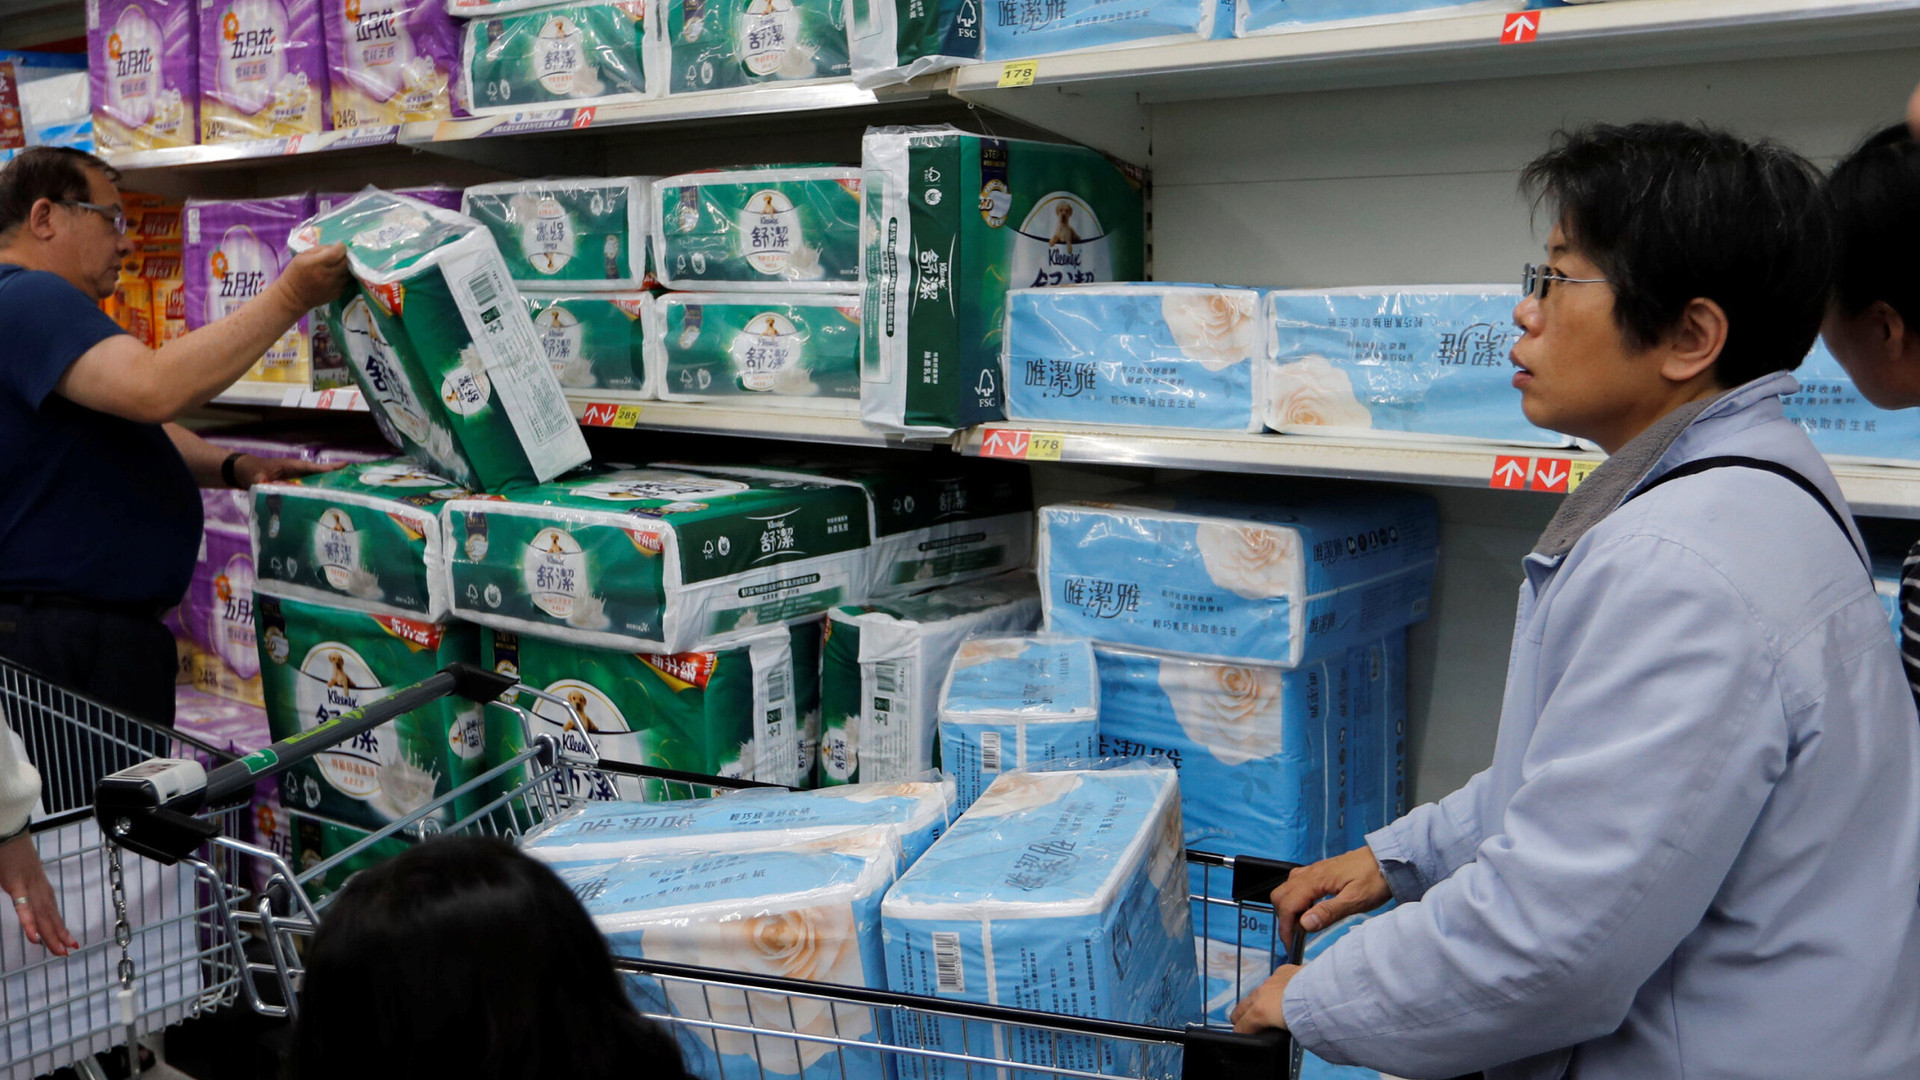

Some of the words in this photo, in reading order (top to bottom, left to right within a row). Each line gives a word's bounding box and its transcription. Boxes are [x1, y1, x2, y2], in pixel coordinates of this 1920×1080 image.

[355, 7, 397, 41] 五月花
[958, 28, 977, 38] FSC
[231, 27, 277, 60] 五月花
[749, 25, 787, 49] 舒潔
[116, 47, 154, 78] 五月花
[1004, 68, 1032, 79] 178
[751, 226, 789, 248] 舒潔
[1048, 249, 1081, 270] Kleenex
[219, 270, 266, 298] 五月花
[919, 248, 939, 300] 舒潔
[745, 347, 789, 370] 舒潔
[1025, 358, 1098, 399] 唯潔雅
[979, 397, 995, 408] FSC
[618, 411, 637, 420] 285
[1033, 440, 1059, 450] 178
[760, 527, 795, 552] 舒潔
[536, 565, 575, 592] 舒潔
[223, 596, 258, 624] 五月
[1064, 577, 1142, 620] 唯潔雅
[327, 689, 360, 708] Kleenex
